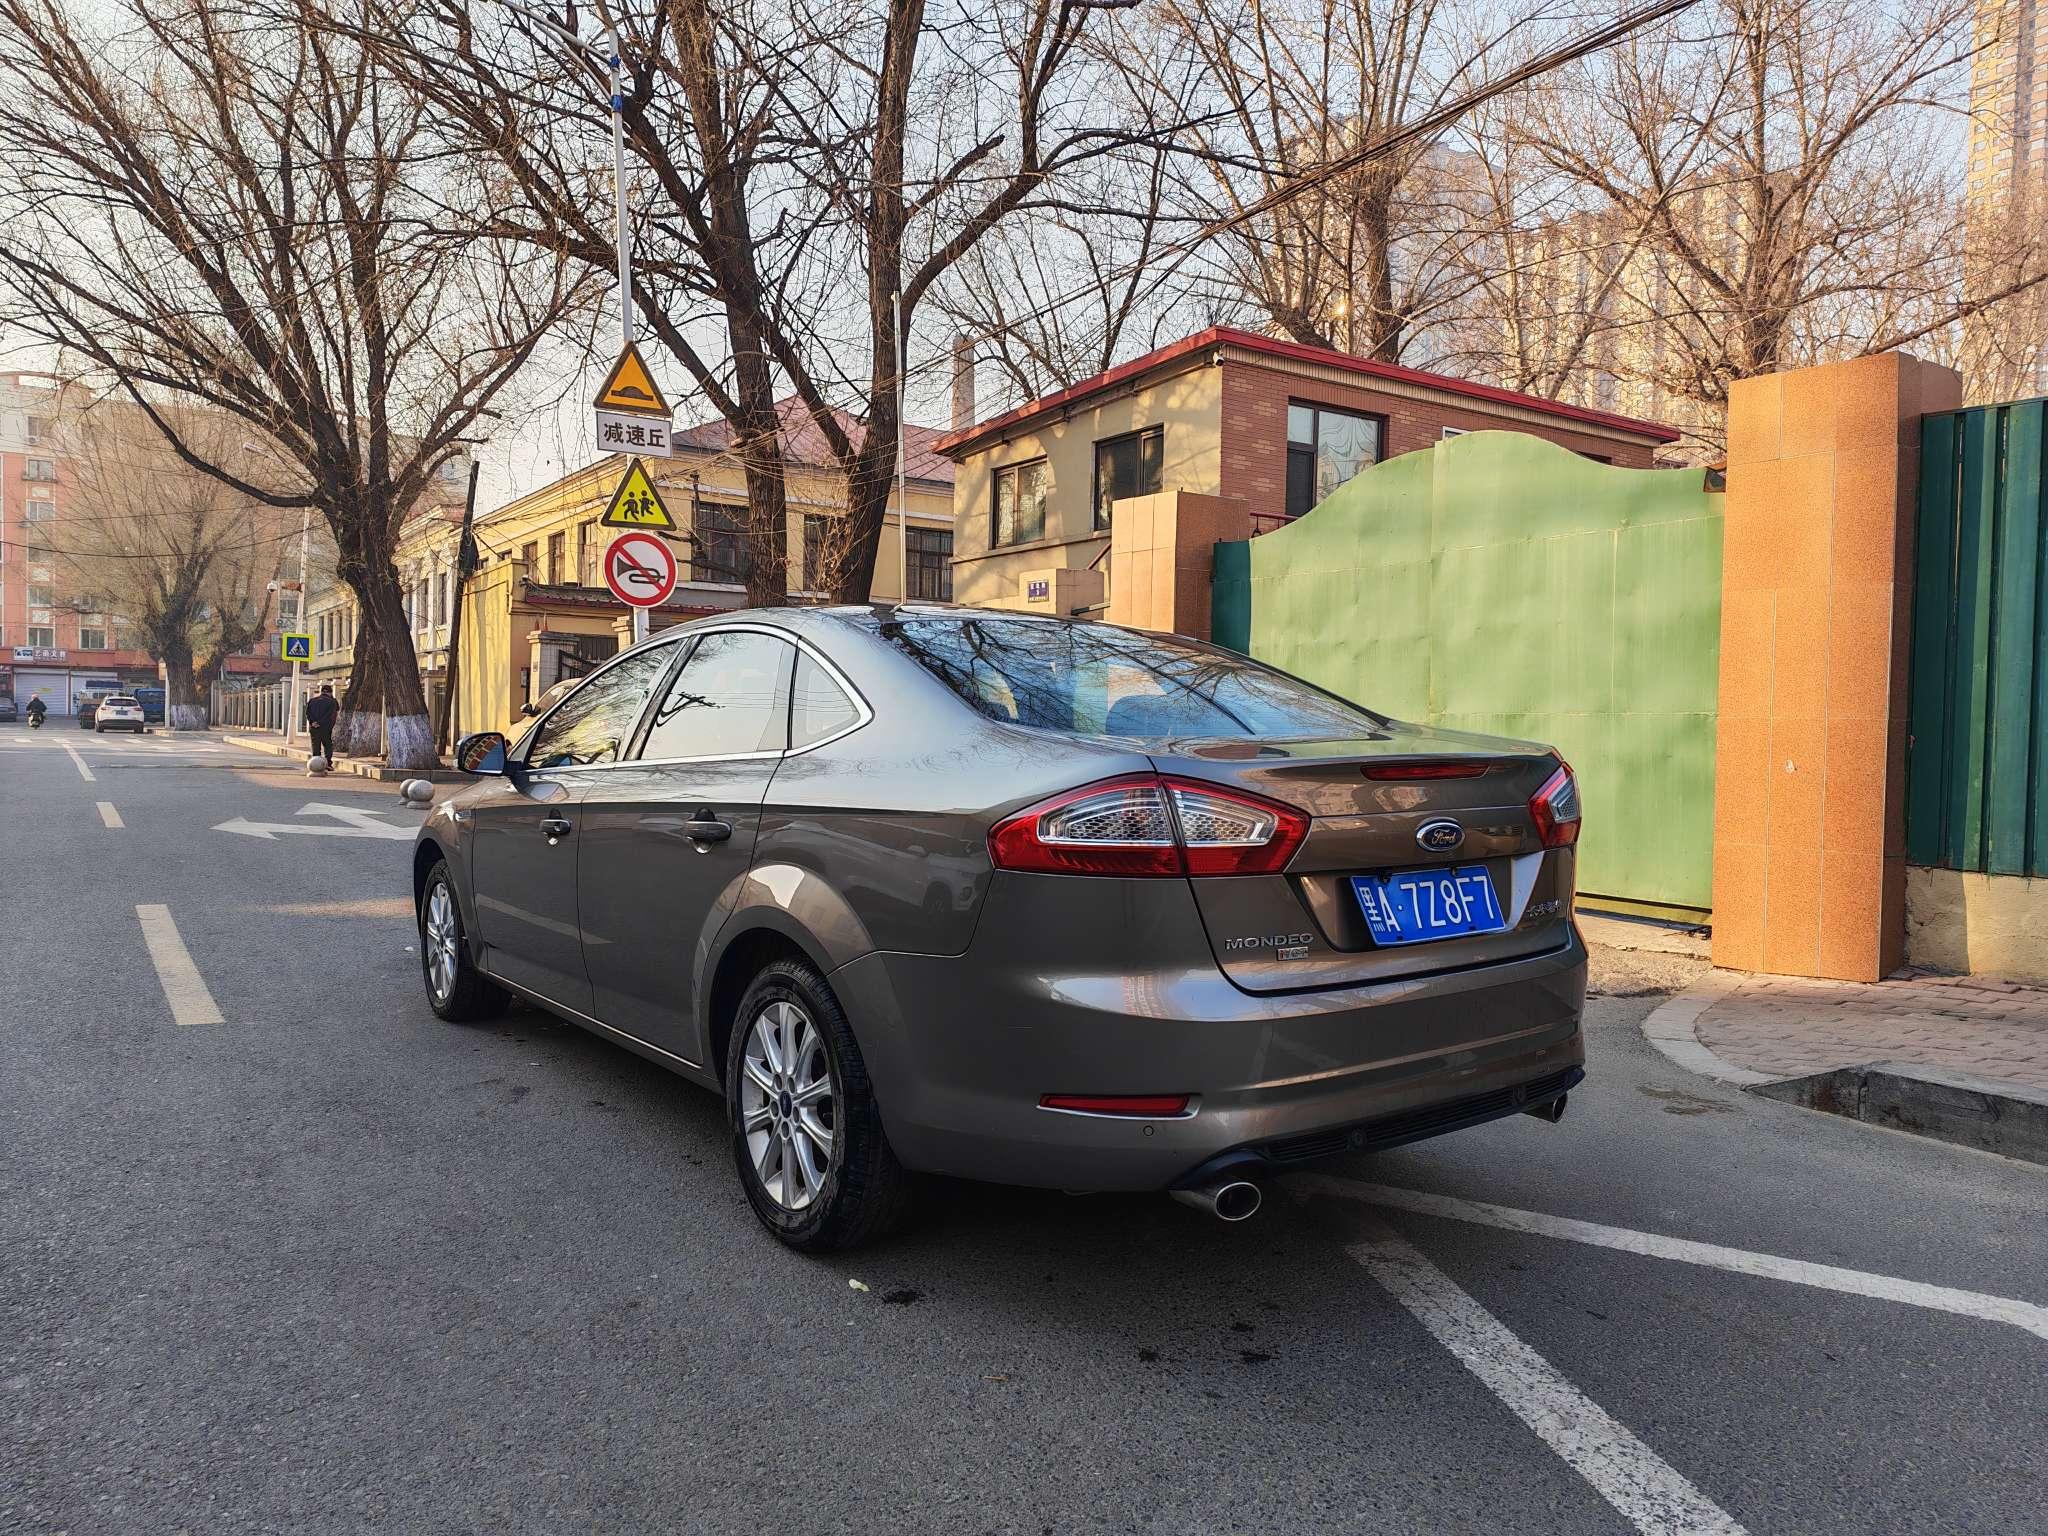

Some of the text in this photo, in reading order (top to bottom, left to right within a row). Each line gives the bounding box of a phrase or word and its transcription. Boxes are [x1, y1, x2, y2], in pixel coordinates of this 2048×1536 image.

[603, 421, 666, 448] 减速丘
[1225, 933, 1314, 950] MONDEO
